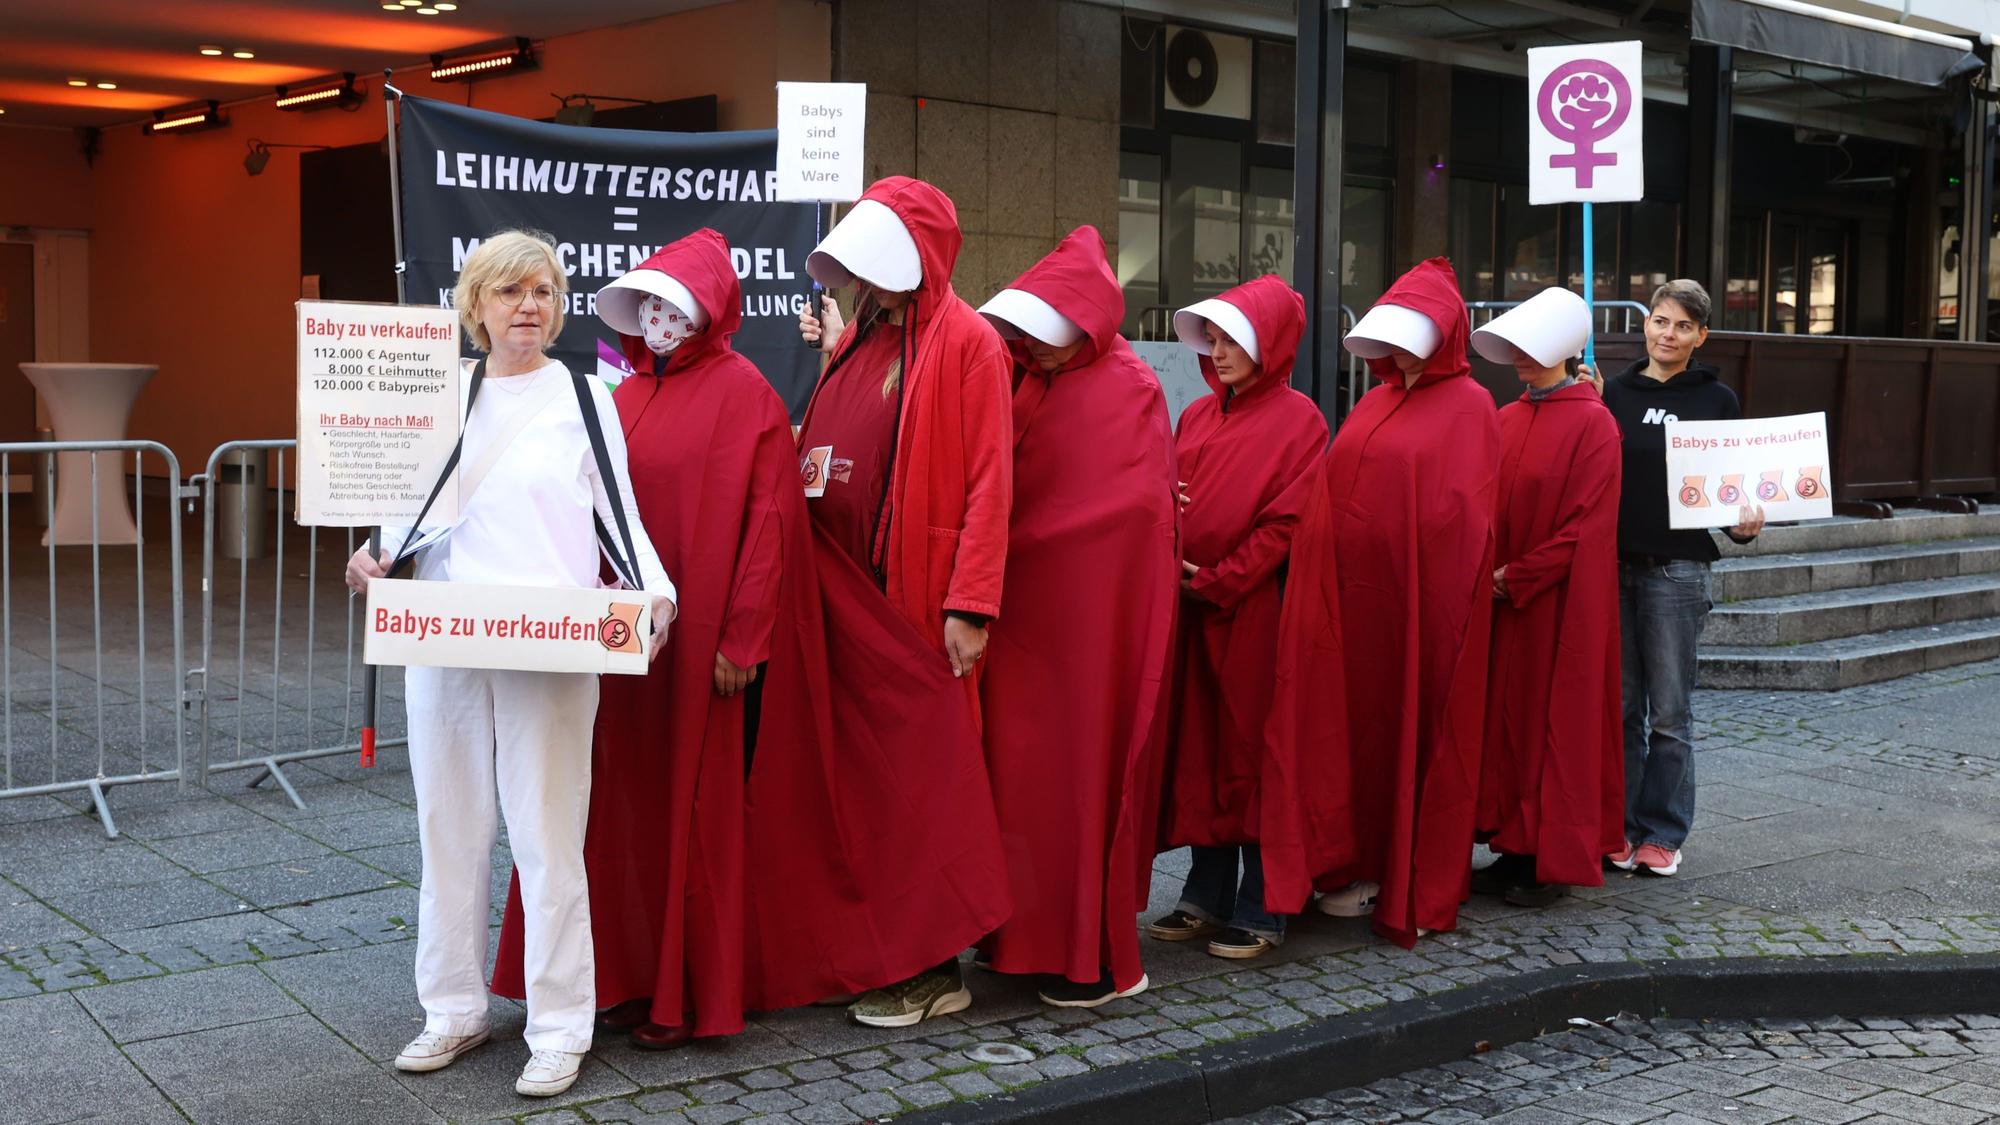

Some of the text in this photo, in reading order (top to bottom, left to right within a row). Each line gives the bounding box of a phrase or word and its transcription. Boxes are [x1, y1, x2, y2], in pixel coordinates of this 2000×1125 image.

[801, 104, 843, 120] Babys
[806, 126, 836, 138] sind
[802, 147, 840, 160] keine
[436, 149, 777, 203] LEIHMUTTERSCHAF
[802, 169, 840, 182] Ware
[306, 317, 452, 341] Baby zu verkaufen!
[313, 347, 431, 363] 112.000 € Agentur
[328, 363, 448, 379] 8.000 € Leihmutter
[313, 379, 364, 392] 120.000
[367, 380, 376, 392] €
[319, 412, 434, 429] Ihr Baby nach Maß!
[383, 441, 399, 450] und
[400, 441, 411, 450] IQ
[1671, 428, 1822, 452] Babys zu verkaufen
[329, 450, 350, 459] nach
[329, 460, 373, 470] Risikofreie
[329, 471, 403, 482] Behinderung oder
[329, 481, 364, 491] falsches
[329, 491, 375, 502] Abtreibung
[376, 491, 389, 501] bis
[400, 492, 426, 501] Monat
[375, 608, 442, 640] Babys
[450, 616, 475, 636] zu
